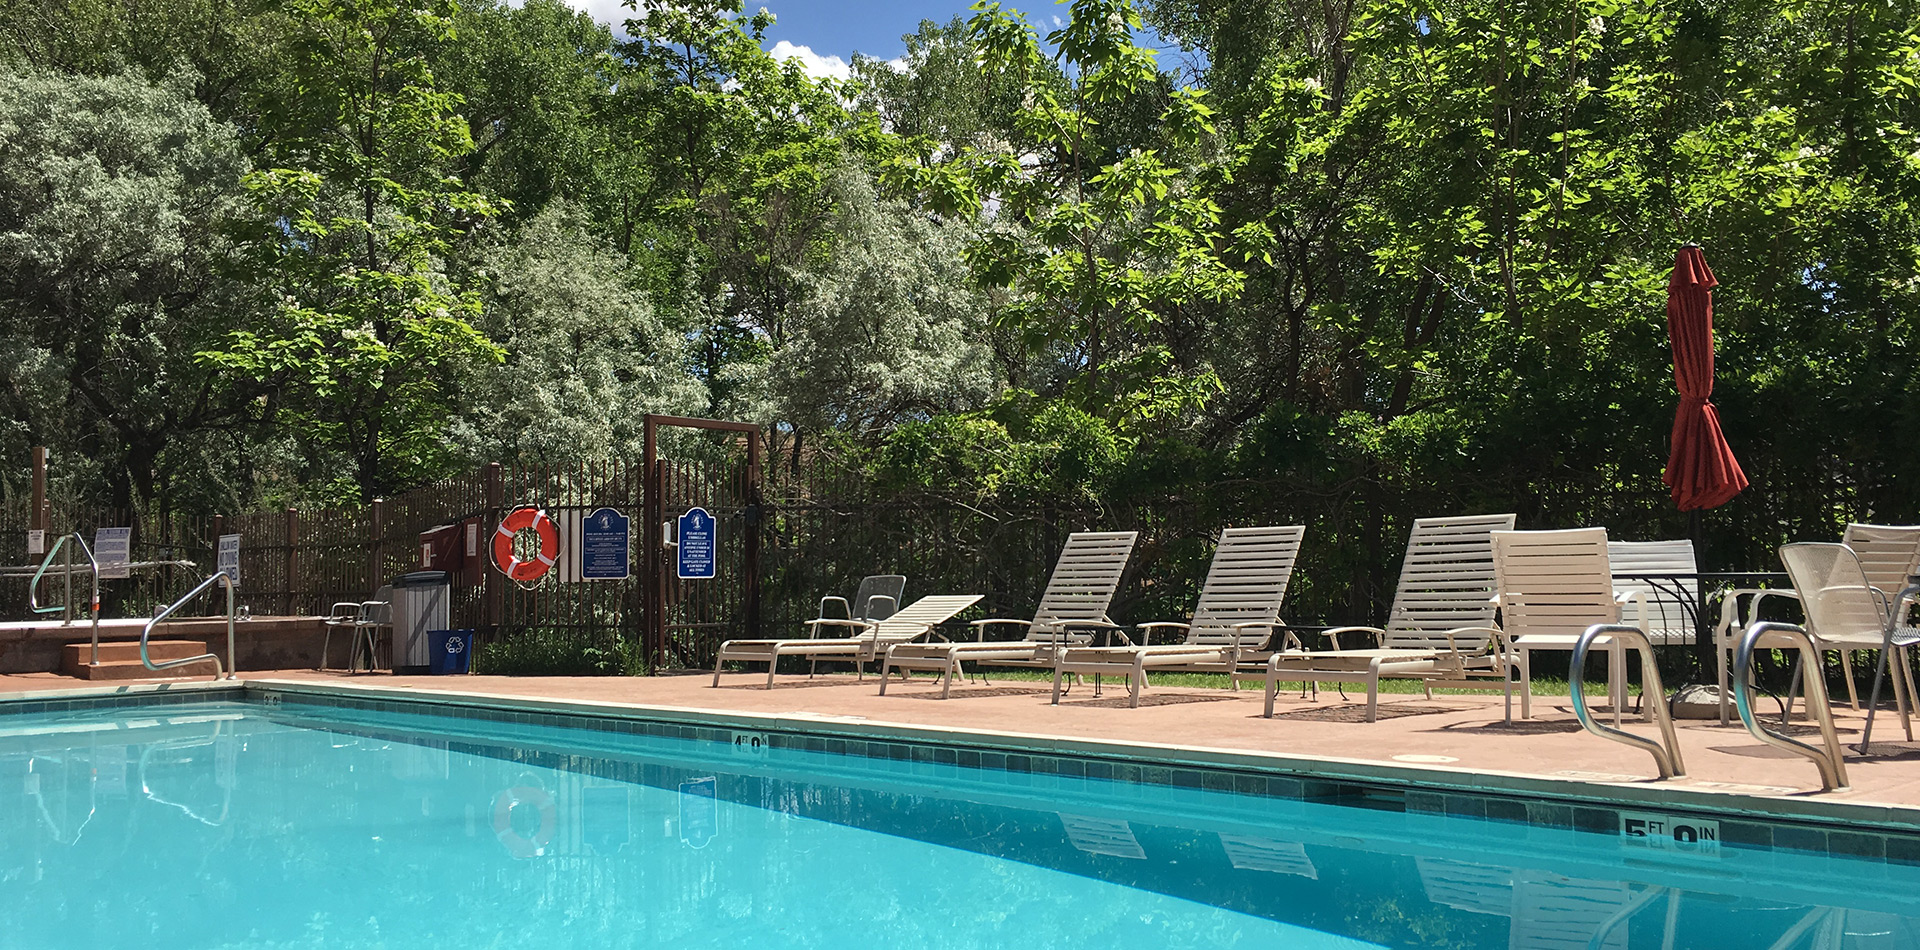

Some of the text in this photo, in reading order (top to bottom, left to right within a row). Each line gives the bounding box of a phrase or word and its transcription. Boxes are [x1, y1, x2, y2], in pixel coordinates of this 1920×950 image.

[1625, 819, 1647, 837] 5
[1649, 821, 1664, 834] FT
[1700, 826, 1714, 840] IN
